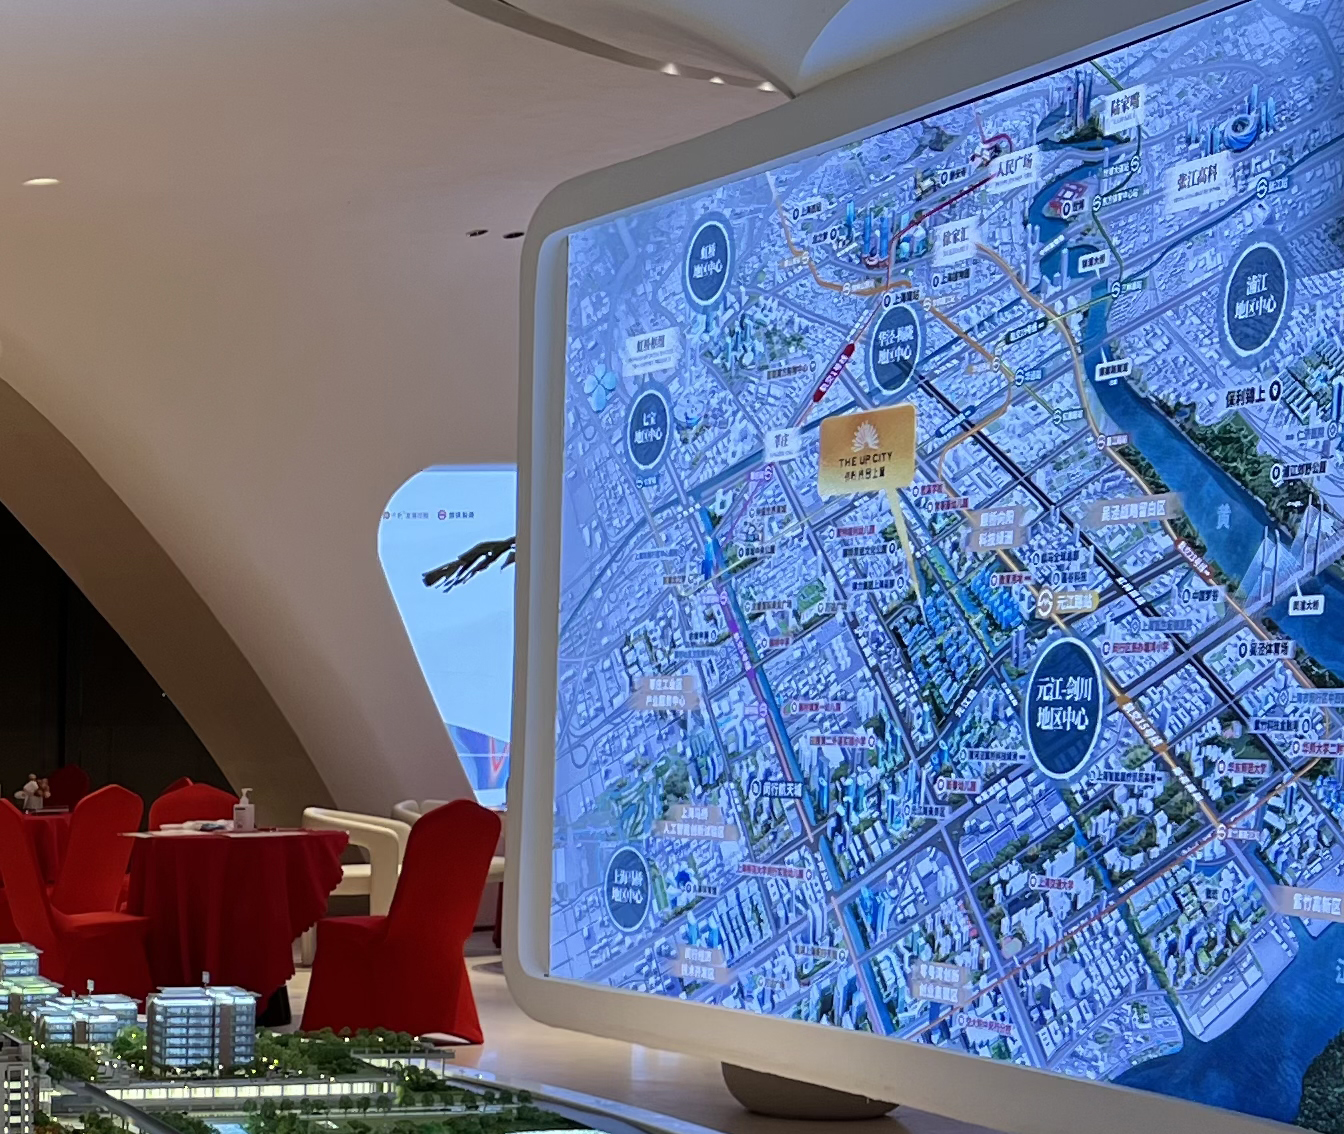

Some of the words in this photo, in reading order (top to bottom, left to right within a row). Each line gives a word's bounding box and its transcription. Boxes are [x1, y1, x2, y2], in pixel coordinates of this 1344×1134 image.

[1111, 92, 1140, 116] 陆家嘴
[997, 154, 1033, 178] 人民广场
[1177, 164, 1218, 191] 张江高科
[1246, 272, 1268, 296] 浦江
[1234, 294, 1277, 320] 地区中心
[839, 457, 857, 468] THE
[859, 454, 871, 466] UP
[873, 451, 893, 464] CITY
[1217, 503, 1231, 530] 黄
[1036, 676, 1093, 702] 元江-剑川
[1036, 706, 1089, 731] 地区中心
[763, 782, 803, 798] 闵行航天城
